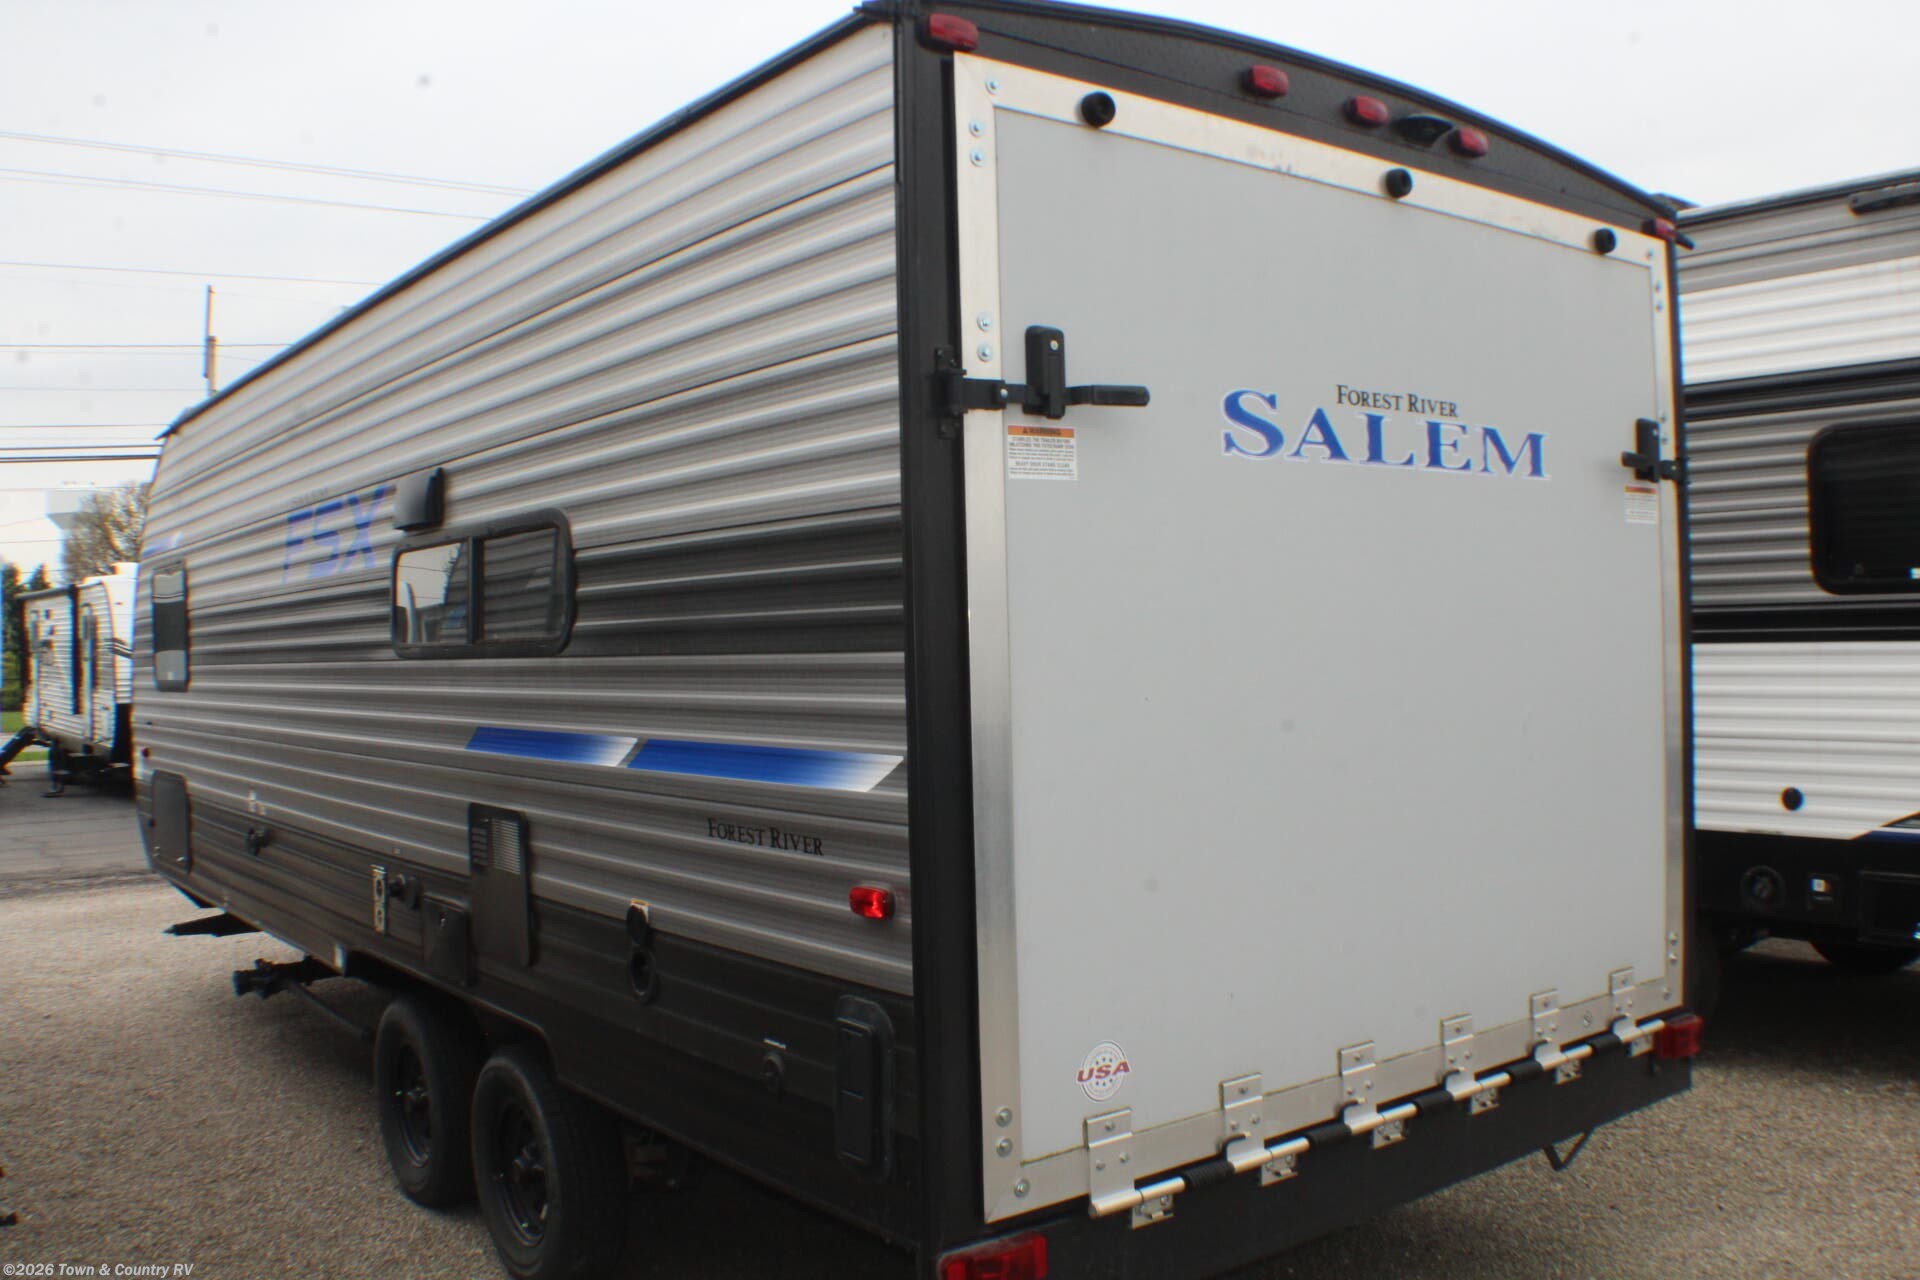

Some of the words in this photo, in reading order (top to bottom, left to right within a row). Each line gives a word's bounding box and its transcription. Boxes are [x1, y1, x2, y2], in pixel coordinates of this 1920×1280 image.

[1336, 384, 1402, 411] FOREST
[1407, 393, 1458, 418] RIVER
[1222, 388, 1550, 479] SALEM
[282, 485, 393, 584] FSX
[707, 816, 765, 846] FOREST
[768, 827, 824, 857] RIVER
[1077, 1061, 1130, 1082] USA
